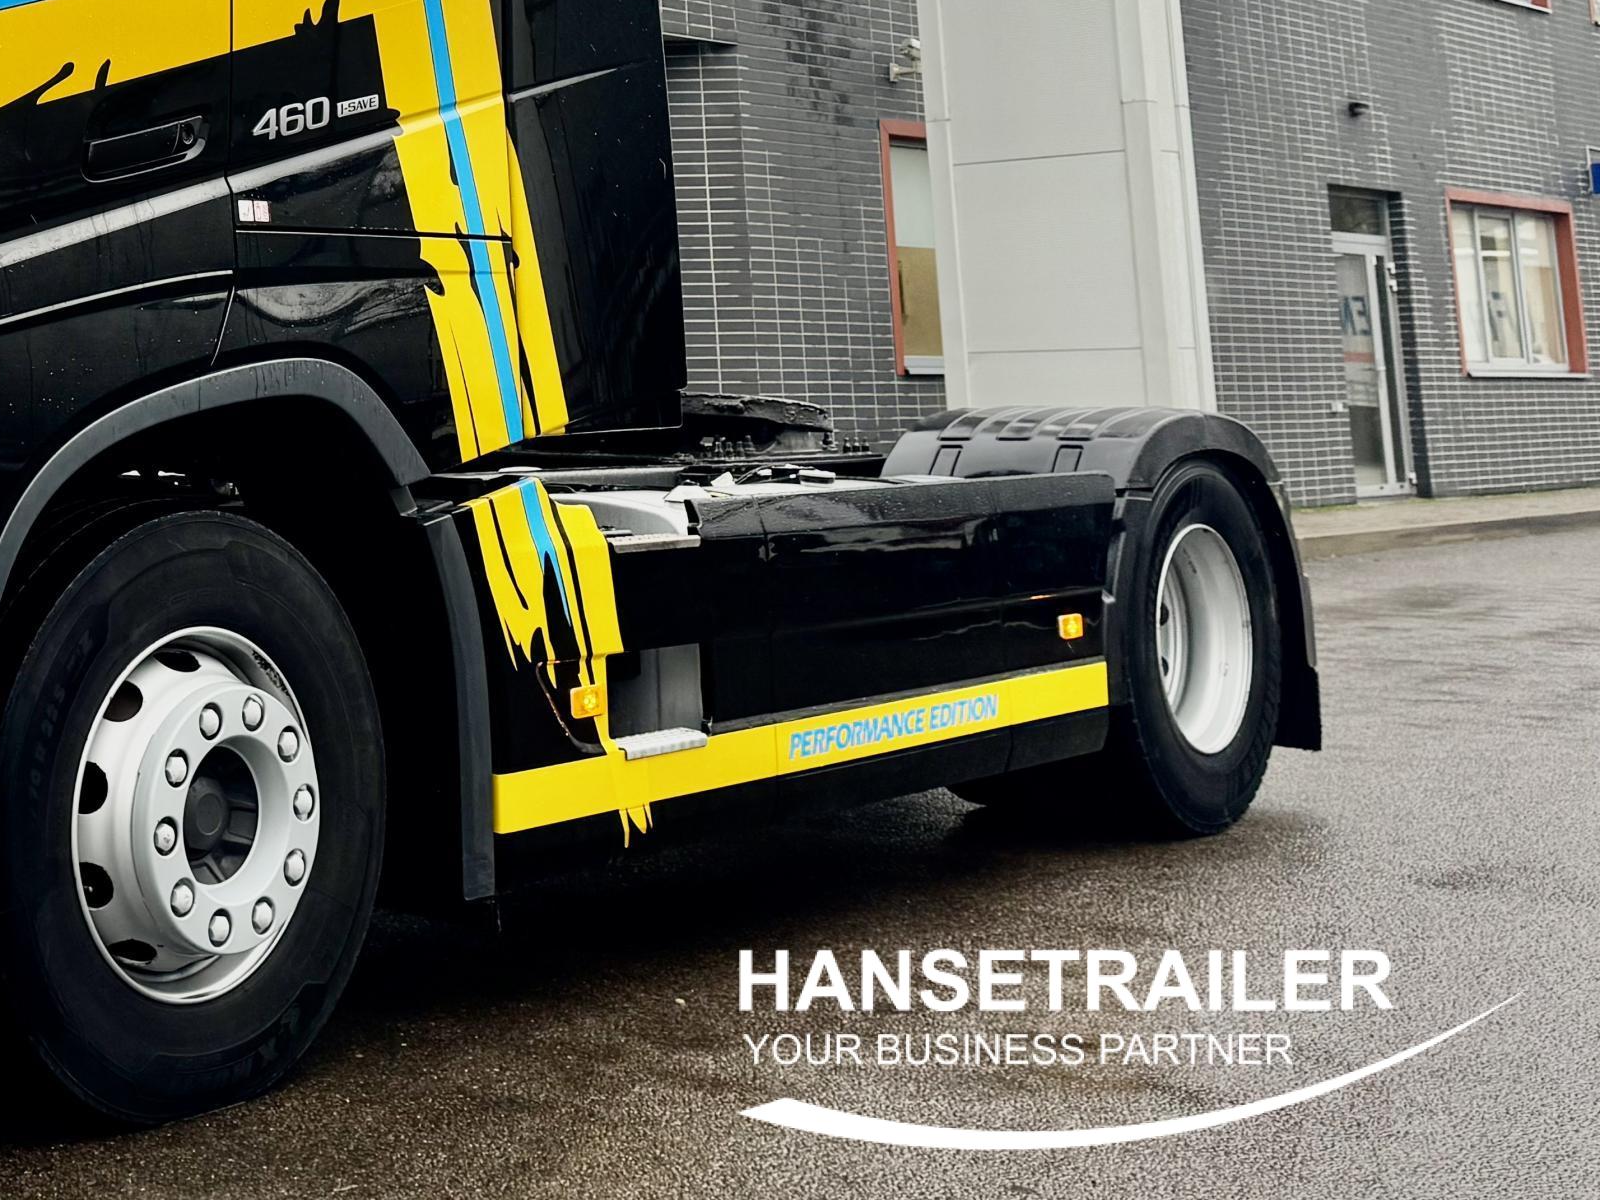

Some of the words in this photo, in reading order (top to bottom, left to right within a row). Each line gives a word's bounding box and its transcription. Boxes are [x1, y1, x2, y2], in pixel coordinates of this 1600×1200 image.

[252, 96, 331, 140] 460
[338, 96, 379, 117] I-SAVE
[788, 708, 926, 760] PERFORMANCE
[929, 694, 998, 731] EDITION
